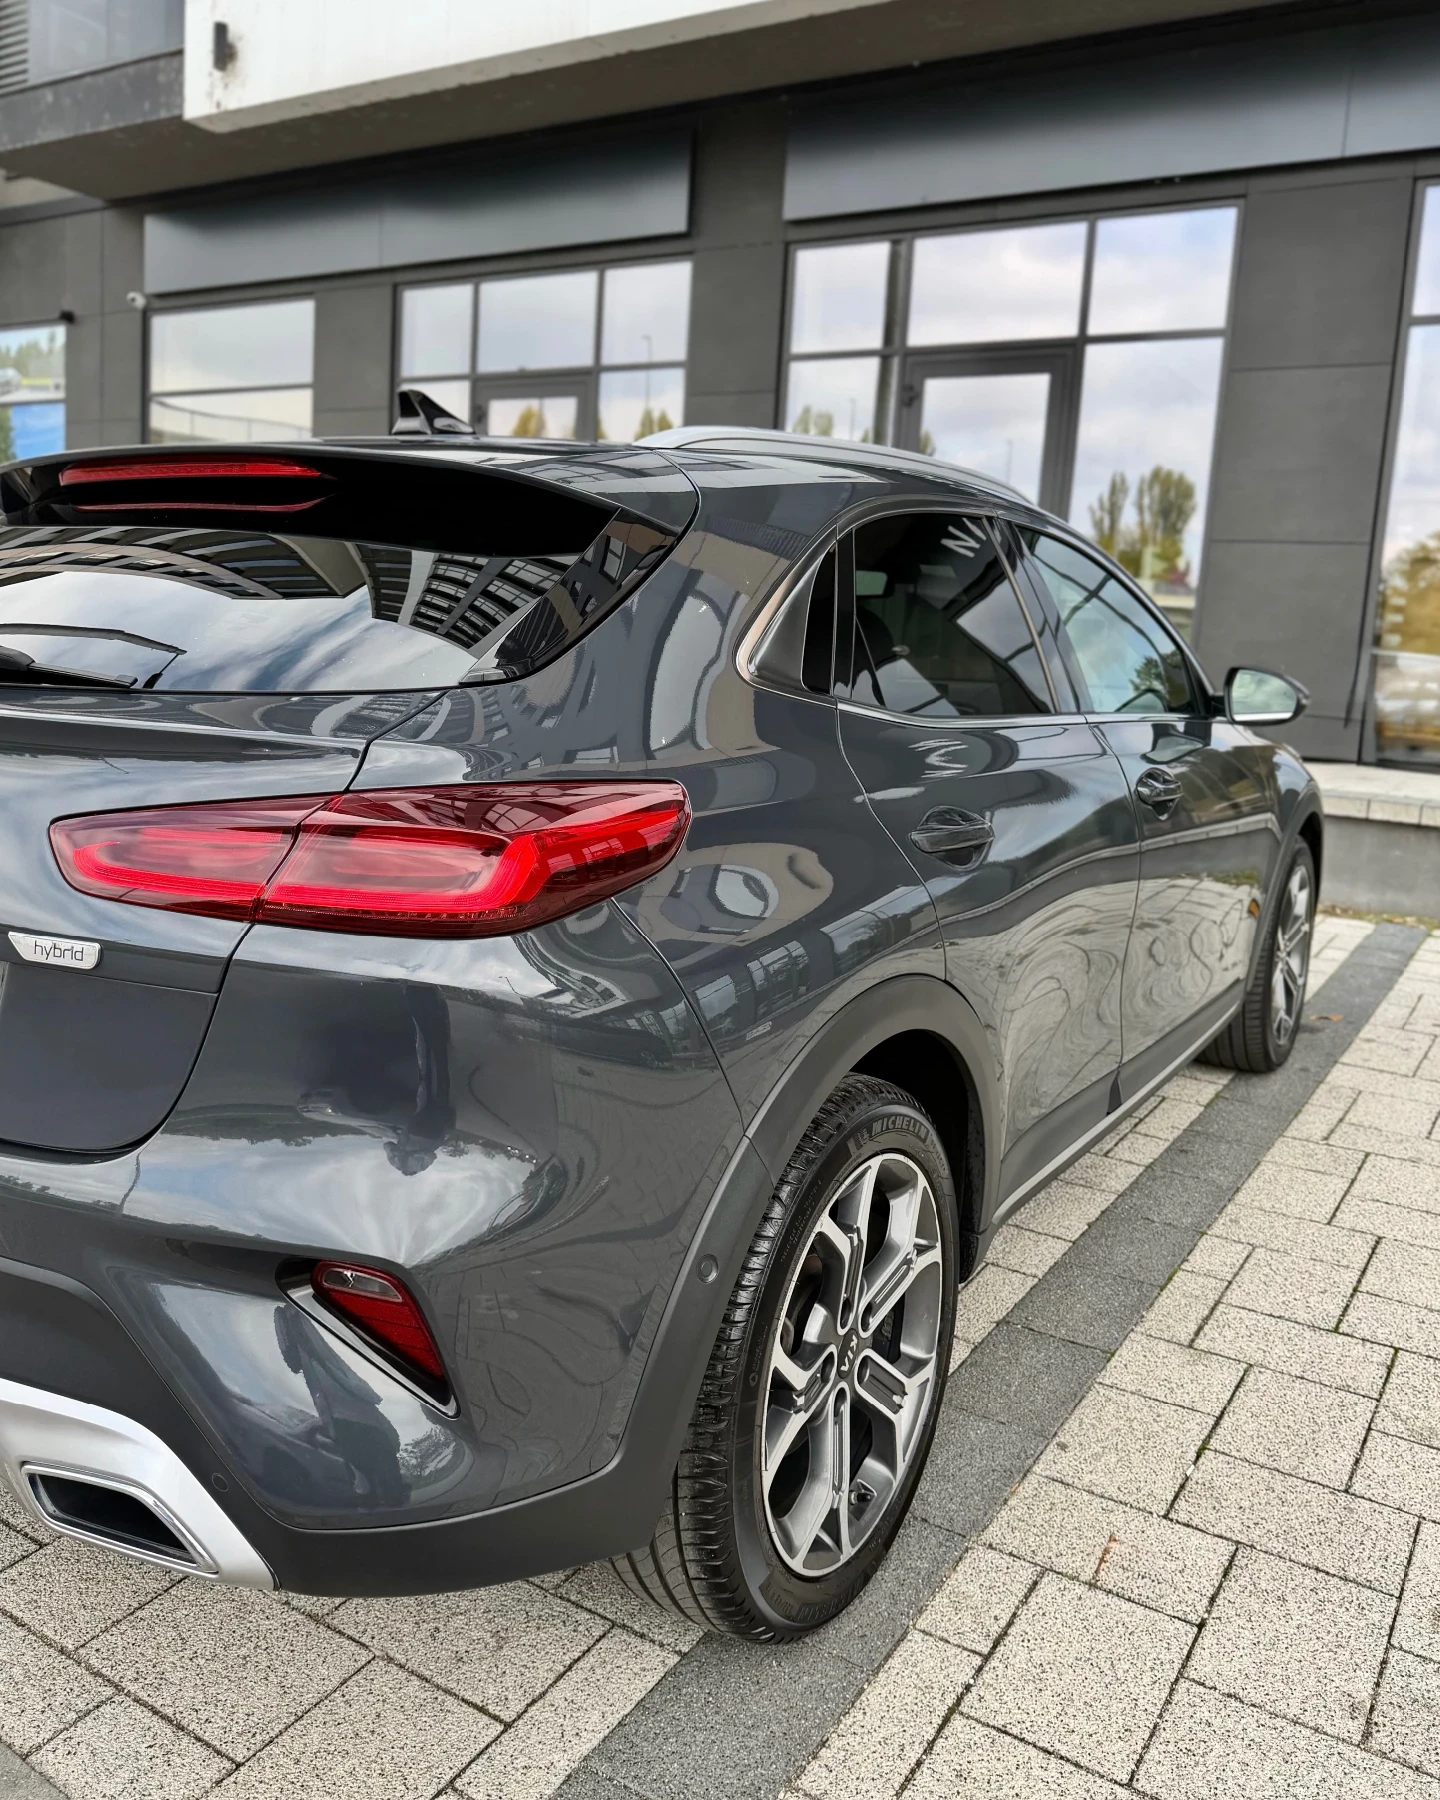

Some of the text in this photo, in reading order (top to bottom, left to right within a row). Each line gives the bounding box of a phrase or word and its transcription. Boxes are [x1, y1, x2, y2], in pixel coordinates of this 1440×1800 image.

[34, 940, 84, 961] hybrid
[871, 1115, 929, 1141] MICHELIN
[840, 1334, 858, 1371] KIA
